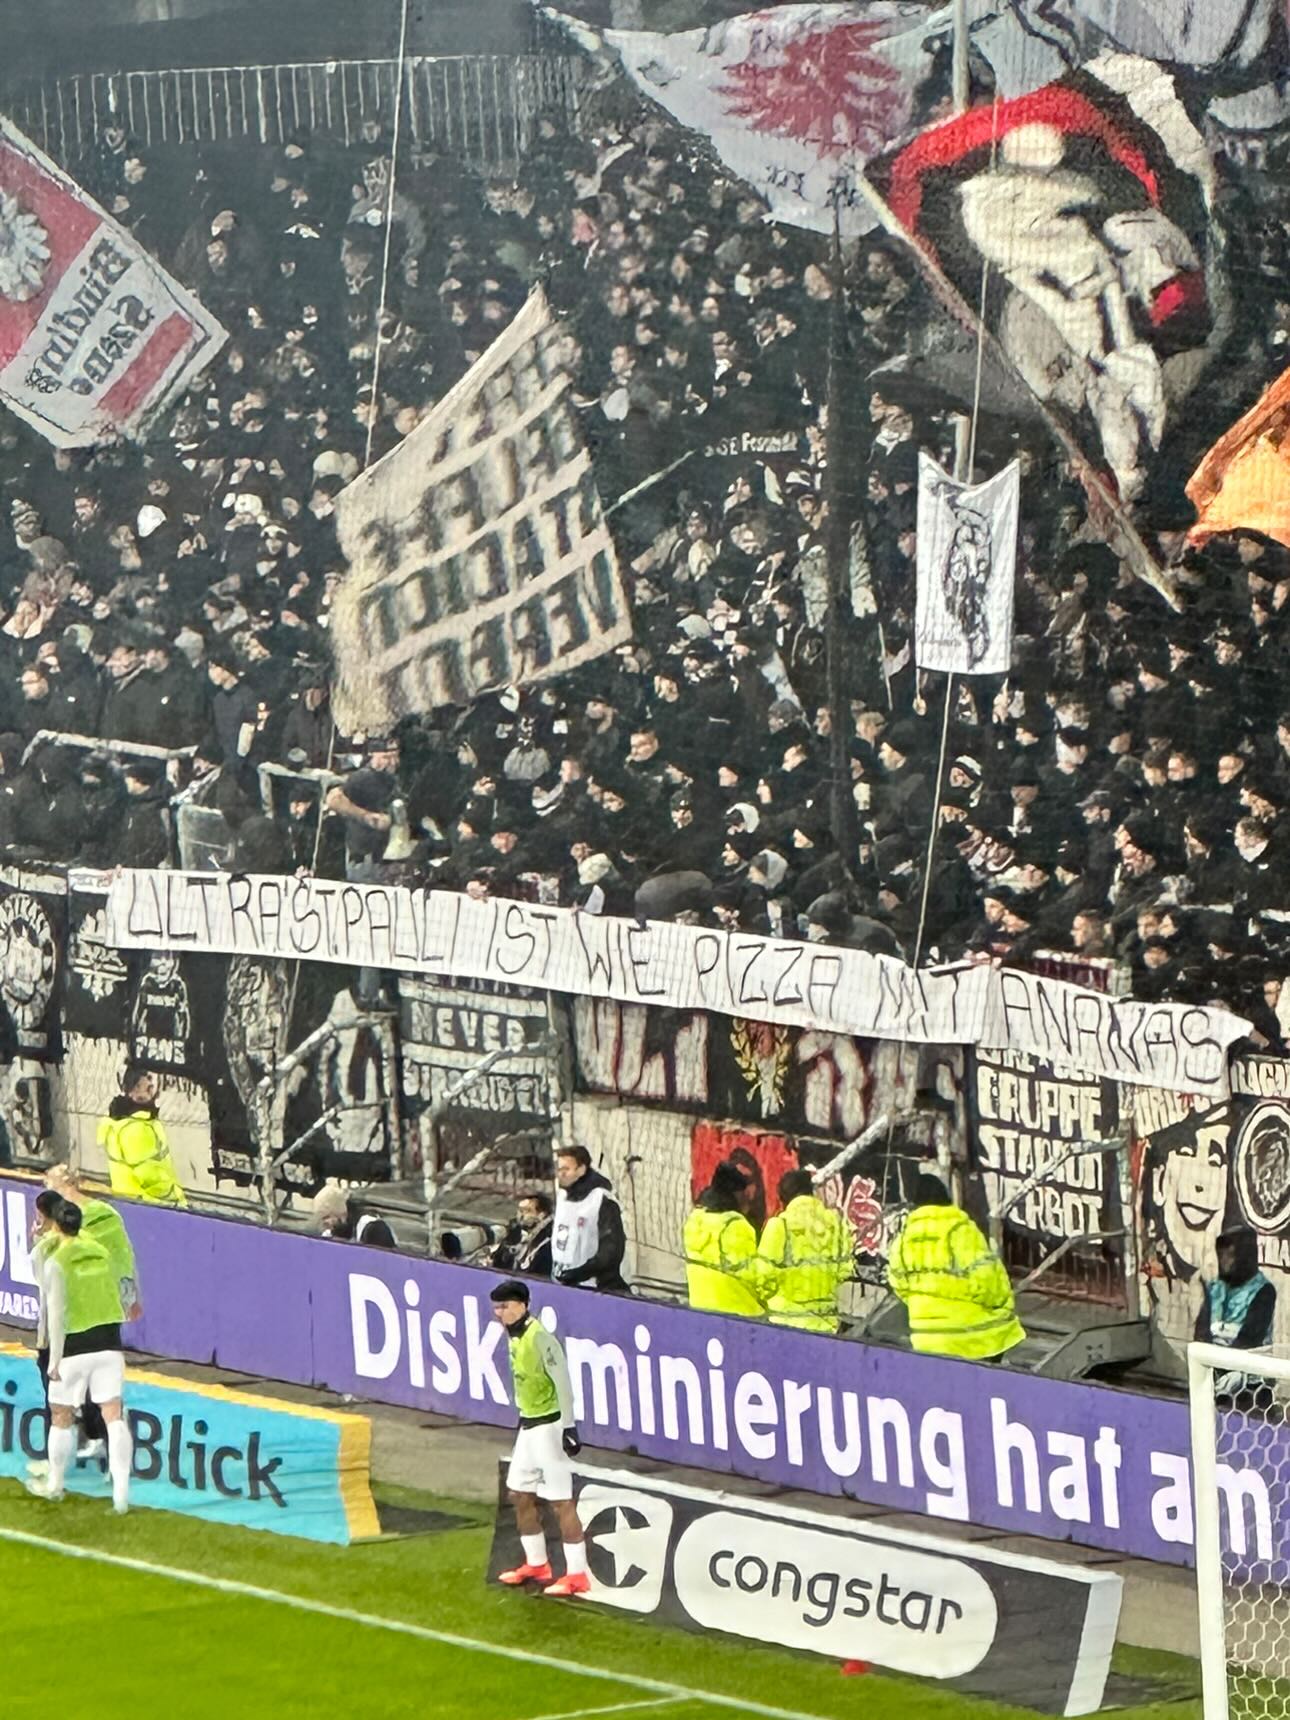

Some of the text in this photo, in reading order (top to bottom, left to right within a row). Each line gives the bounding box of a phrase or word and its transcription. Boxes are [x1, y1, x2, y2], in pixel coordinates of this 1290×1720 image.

[486, 901, 557, 978] IST
[574, 909, 665, 995] WIE
[695, 931, 842, 1020] PIZZA
[1001, 972, 1222, 1084] ANANAS
[977, 1065, 1102, 1142] GRUPPE
[978, 1124, 1103, 1192] STADION
[349, 1272, 970, 1522] Diskminierung
[990, 1397, 1122, 1529] hat
[127, 1408, 288, 1508] Blick
[709, 1550, 962, 1634] congstar
